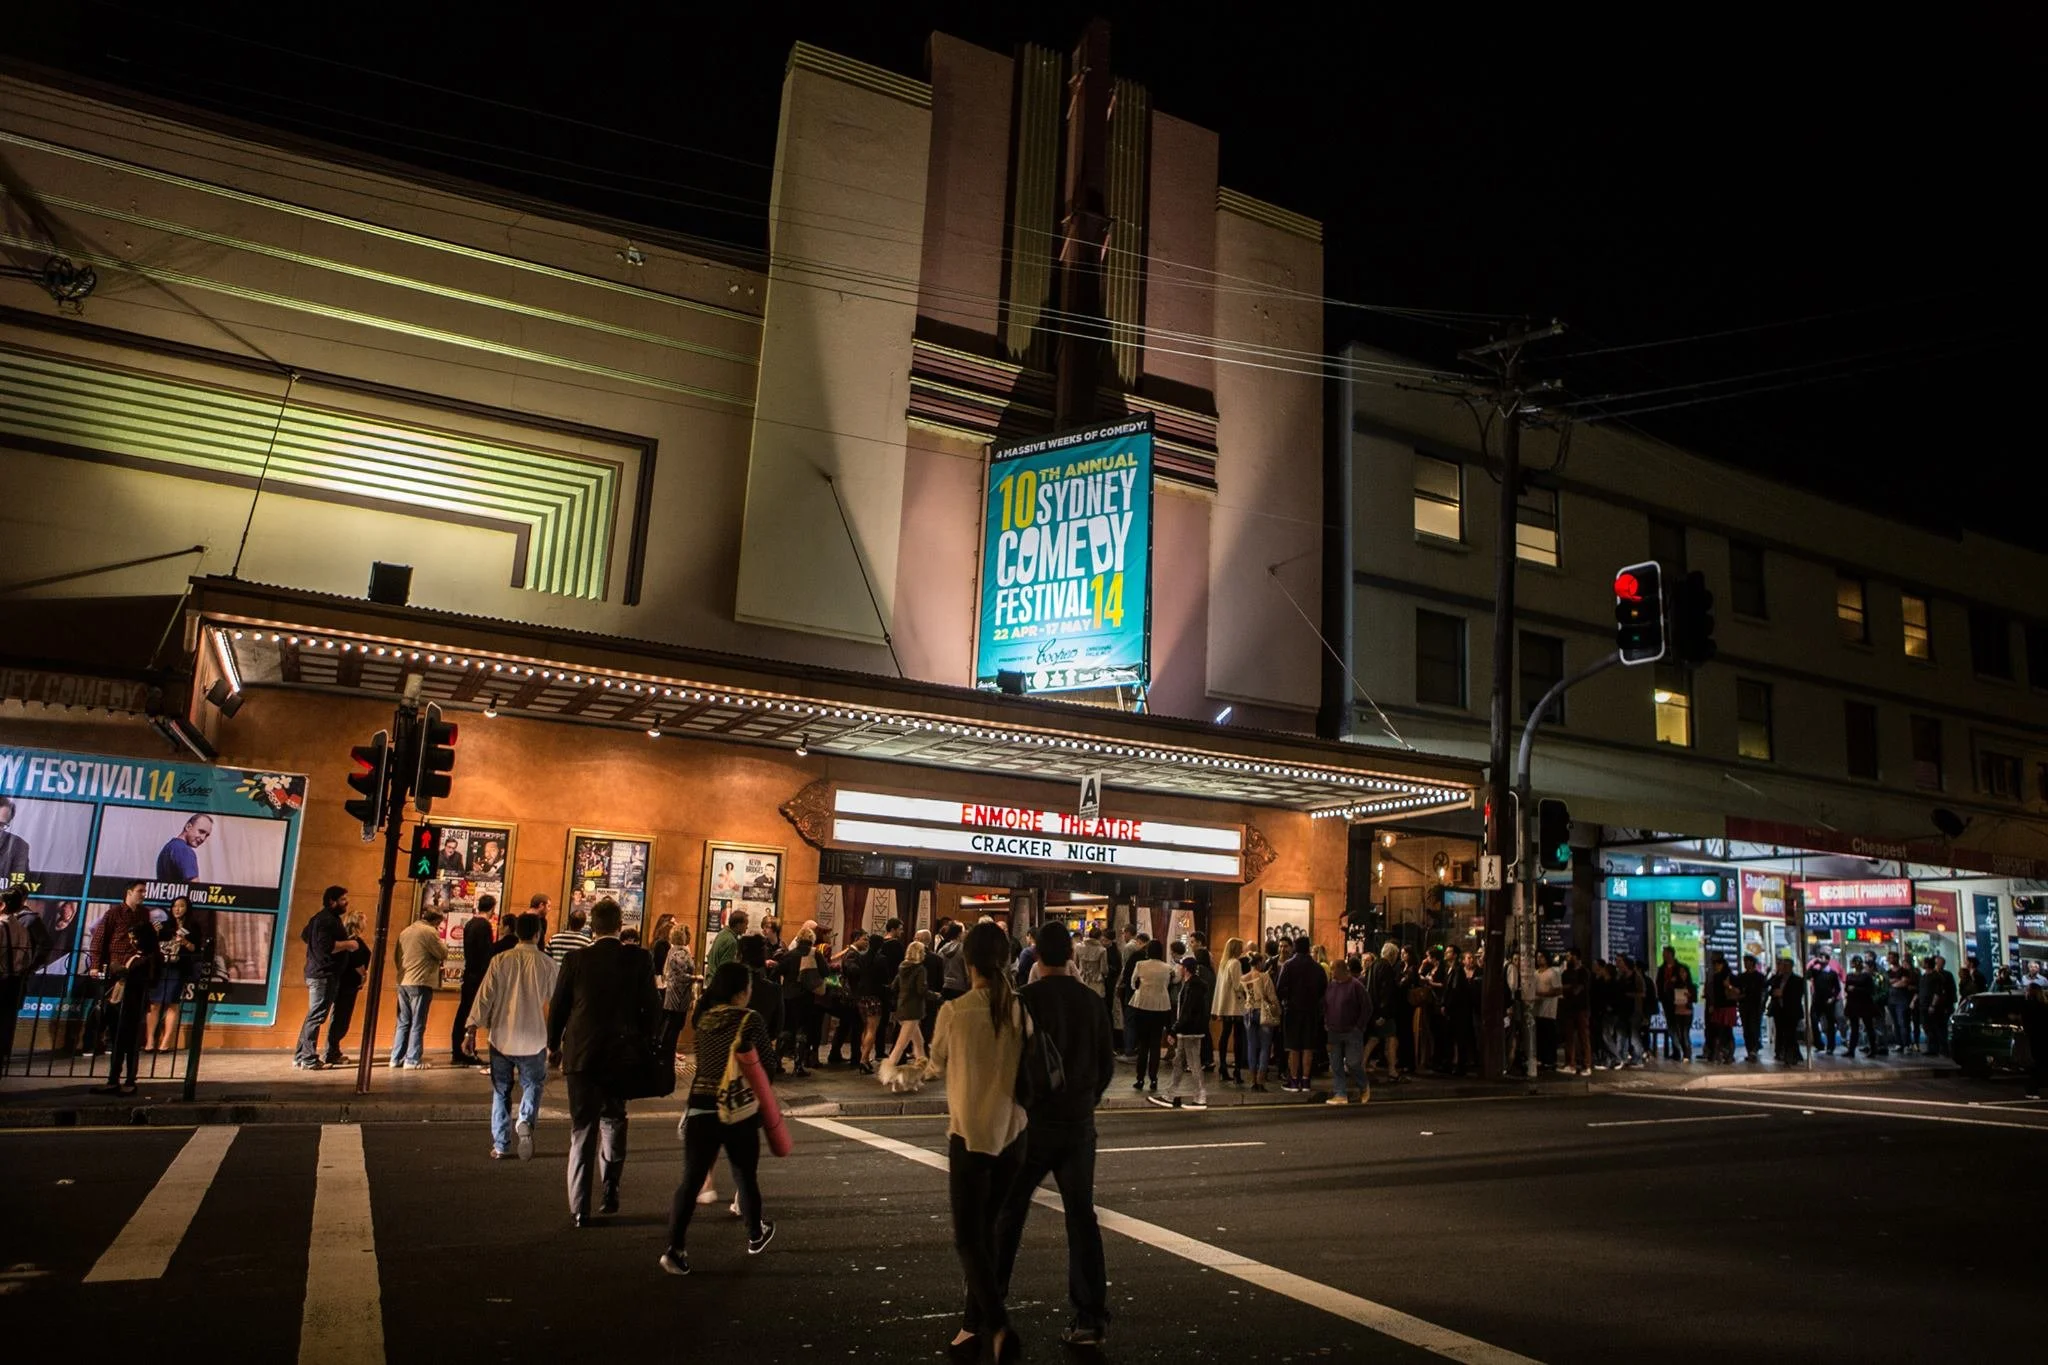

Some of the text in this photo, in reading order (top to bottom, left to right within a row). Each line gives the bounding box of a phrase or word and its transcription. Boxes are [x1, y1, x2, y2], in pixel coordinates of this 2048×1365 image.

[996, 420, 1148, 459] 4 MASSIVE WEEKS OF COMEDY!
[1064, 452, 1139, 478] ANNUAL
[1036, 468, 1137, 525] SYDNEY
[996, 511, 1134, 587] COMEDY
[994, 571, 1124, 629] FESTIVAL 14
[993, 628, 1009, 641] 22
[1011, 624, 1037, 639] APR
[1046, 622, 1056, 636] 17
[1061, 619, 1093, 634] MAY
[25, 756, 146, 801] FESTIVAL
[149, 769, 176, 803] 14
[1081, 777, 1098, 808] A
[961, 803, 1142, 841] ENMORE THEATRE
[971, 835, 1117, 863] CRACKER NIGHT
[10, 871, 26, 883] 15
[208, 885, 222, 895] 17
[189, 889, 208, 904] (UK)
[207, 894, 237, 905] MAY
[1818, 882, 1909, 900] DISCOUNT PHARMACY
[207, 992, 226, 1002] AY
